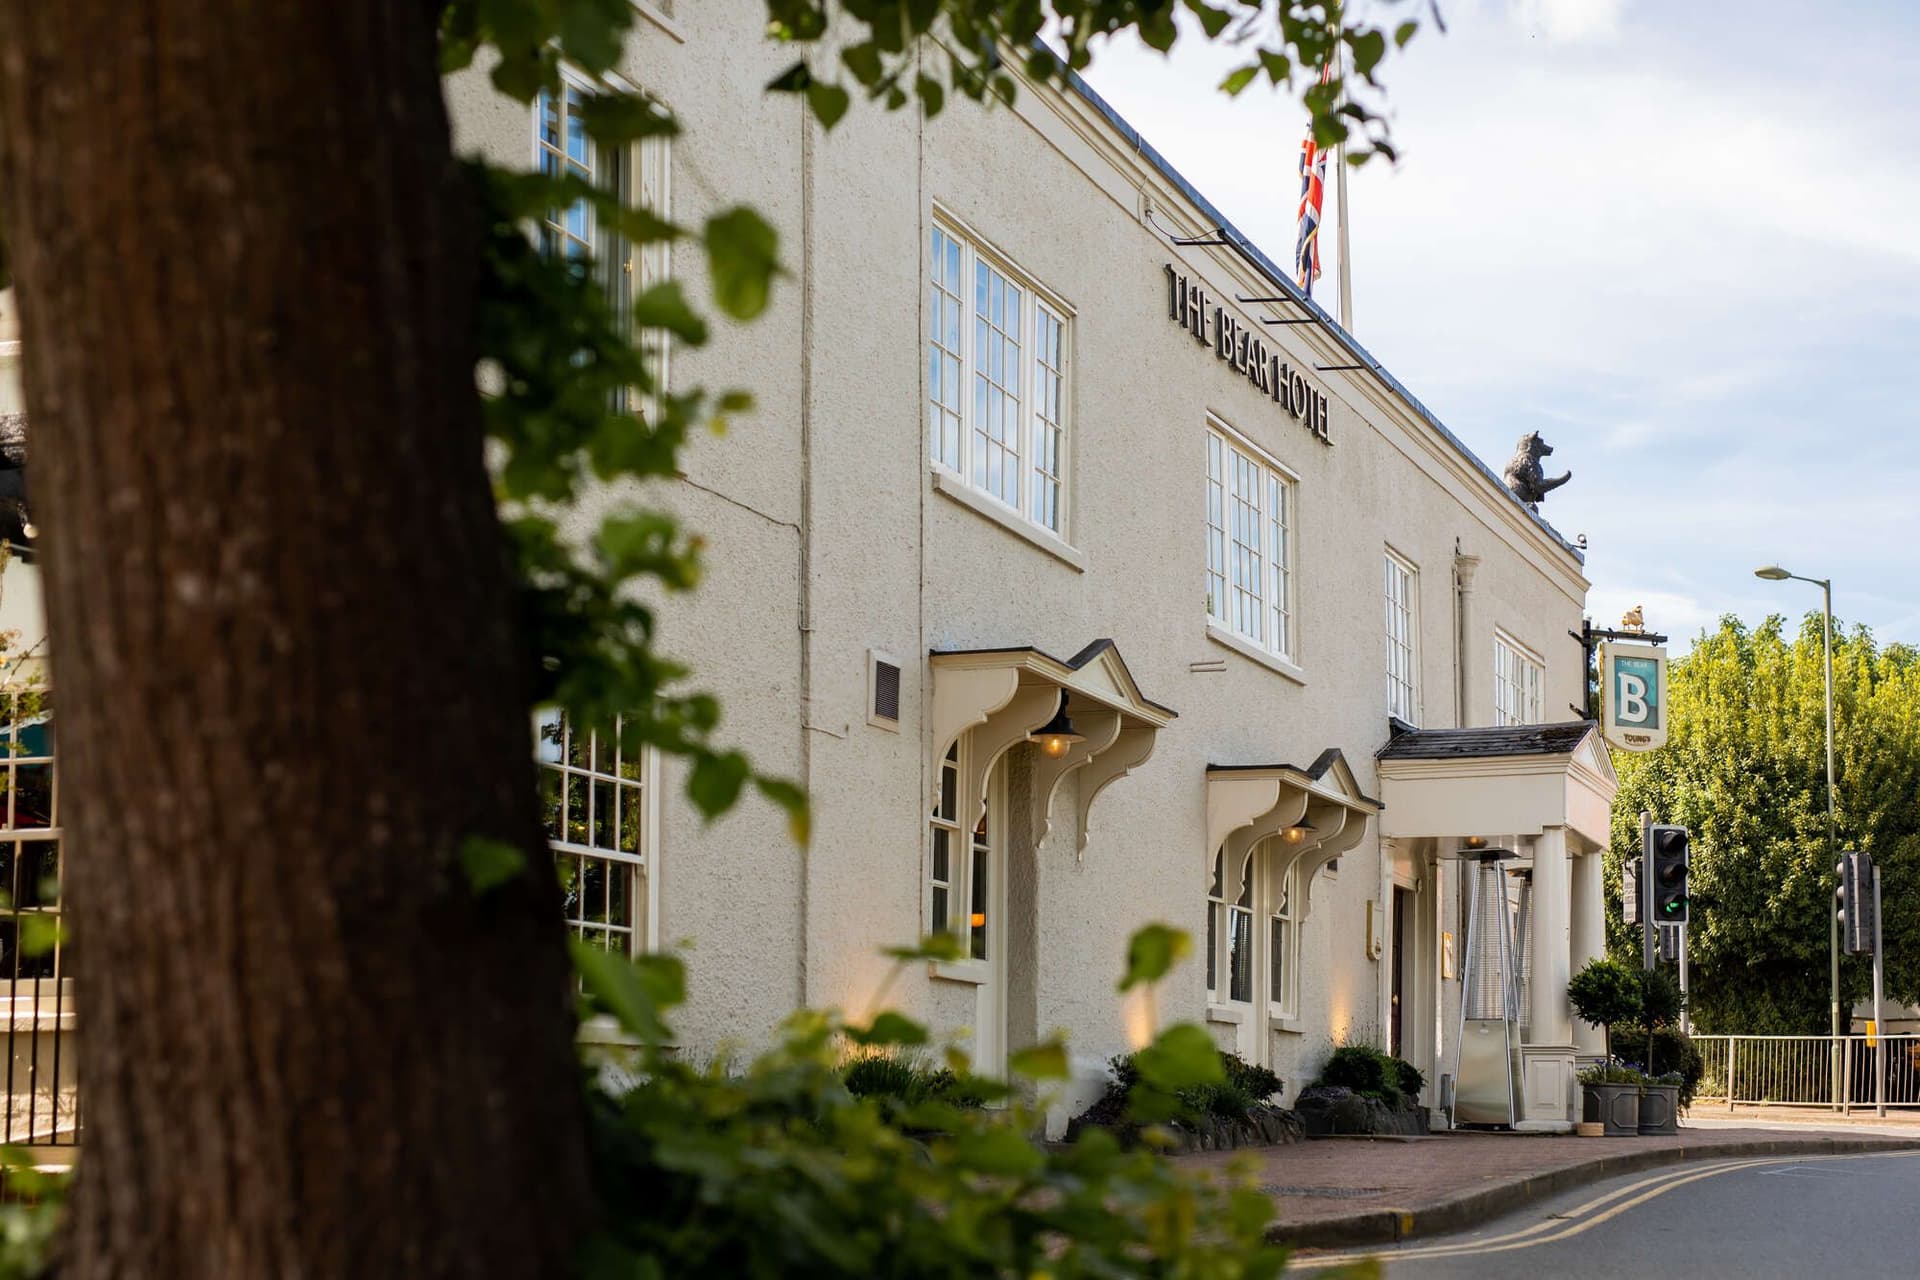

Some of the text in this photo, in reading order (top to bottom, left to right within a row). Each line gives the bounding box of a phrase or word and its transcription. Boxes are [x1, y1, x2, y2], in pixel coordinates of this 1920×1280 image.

[1163, 263, 1335, 446] THE BEAR HOTEL
[1618, 672, 1648, 723] B
